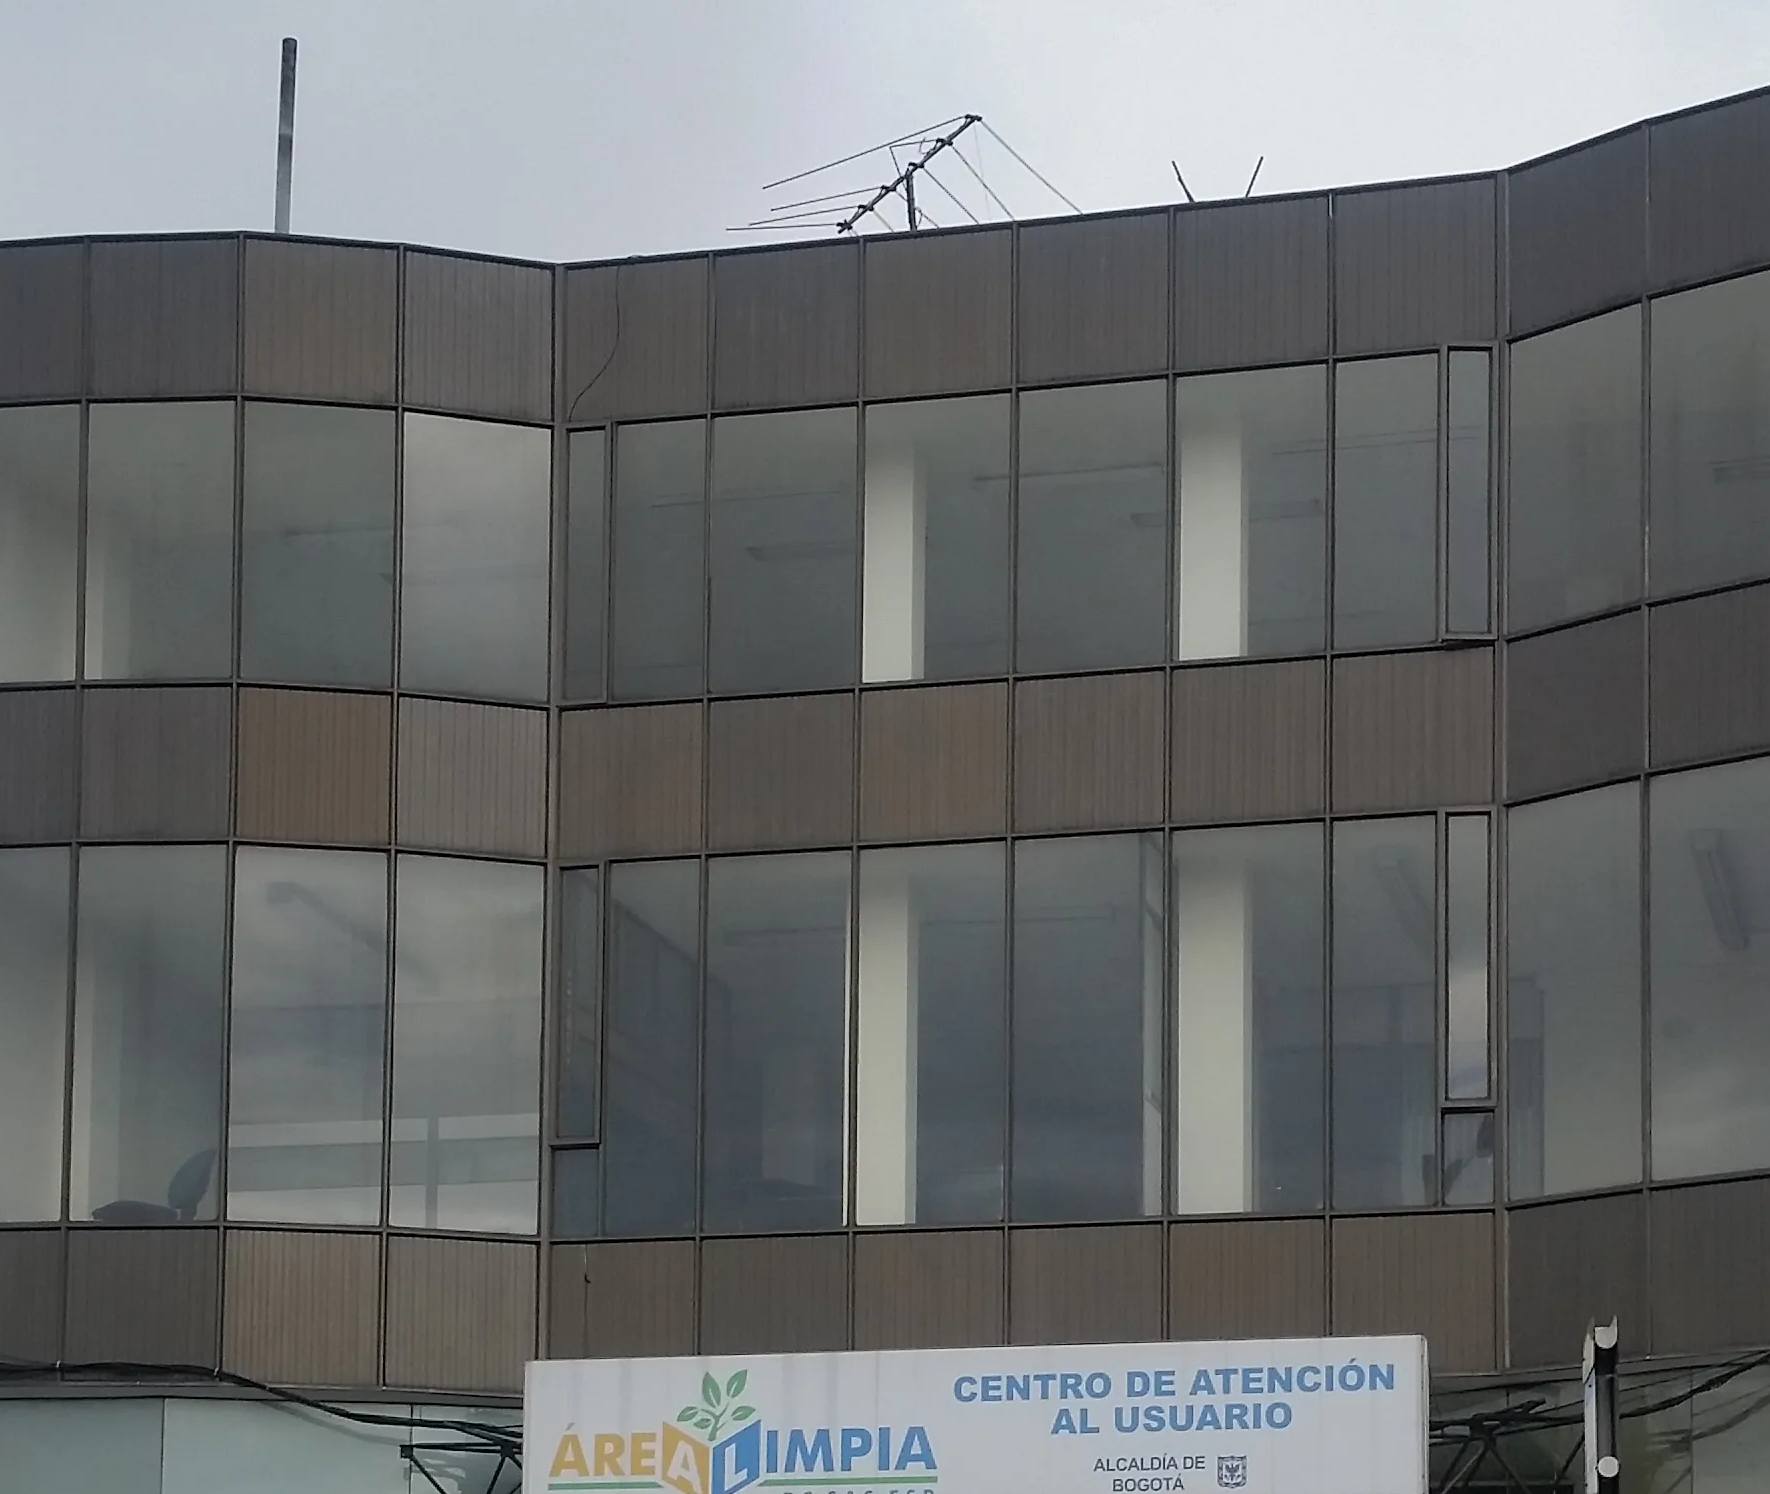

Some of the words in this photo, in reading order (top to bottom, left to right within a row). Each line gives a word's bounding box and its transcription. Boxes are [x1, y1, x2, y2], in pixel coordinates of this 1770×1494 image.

[953, 1371, 1112, 1402] CENTRO
[1125, 1370, 1177, 1398] DE
[1189, 1358, 1395, 1396] ATENCIÓN
[1050, 1408, 1100, 1435] AL
[1113, 1401, 1293, 1433] USUARIO
[1093, 1454, 1179, 1473] ALCALDÍA
[1183, 1455, 1206, 1470] DE
[1111, 1473, 1185, 1493] BOGOTÁ
